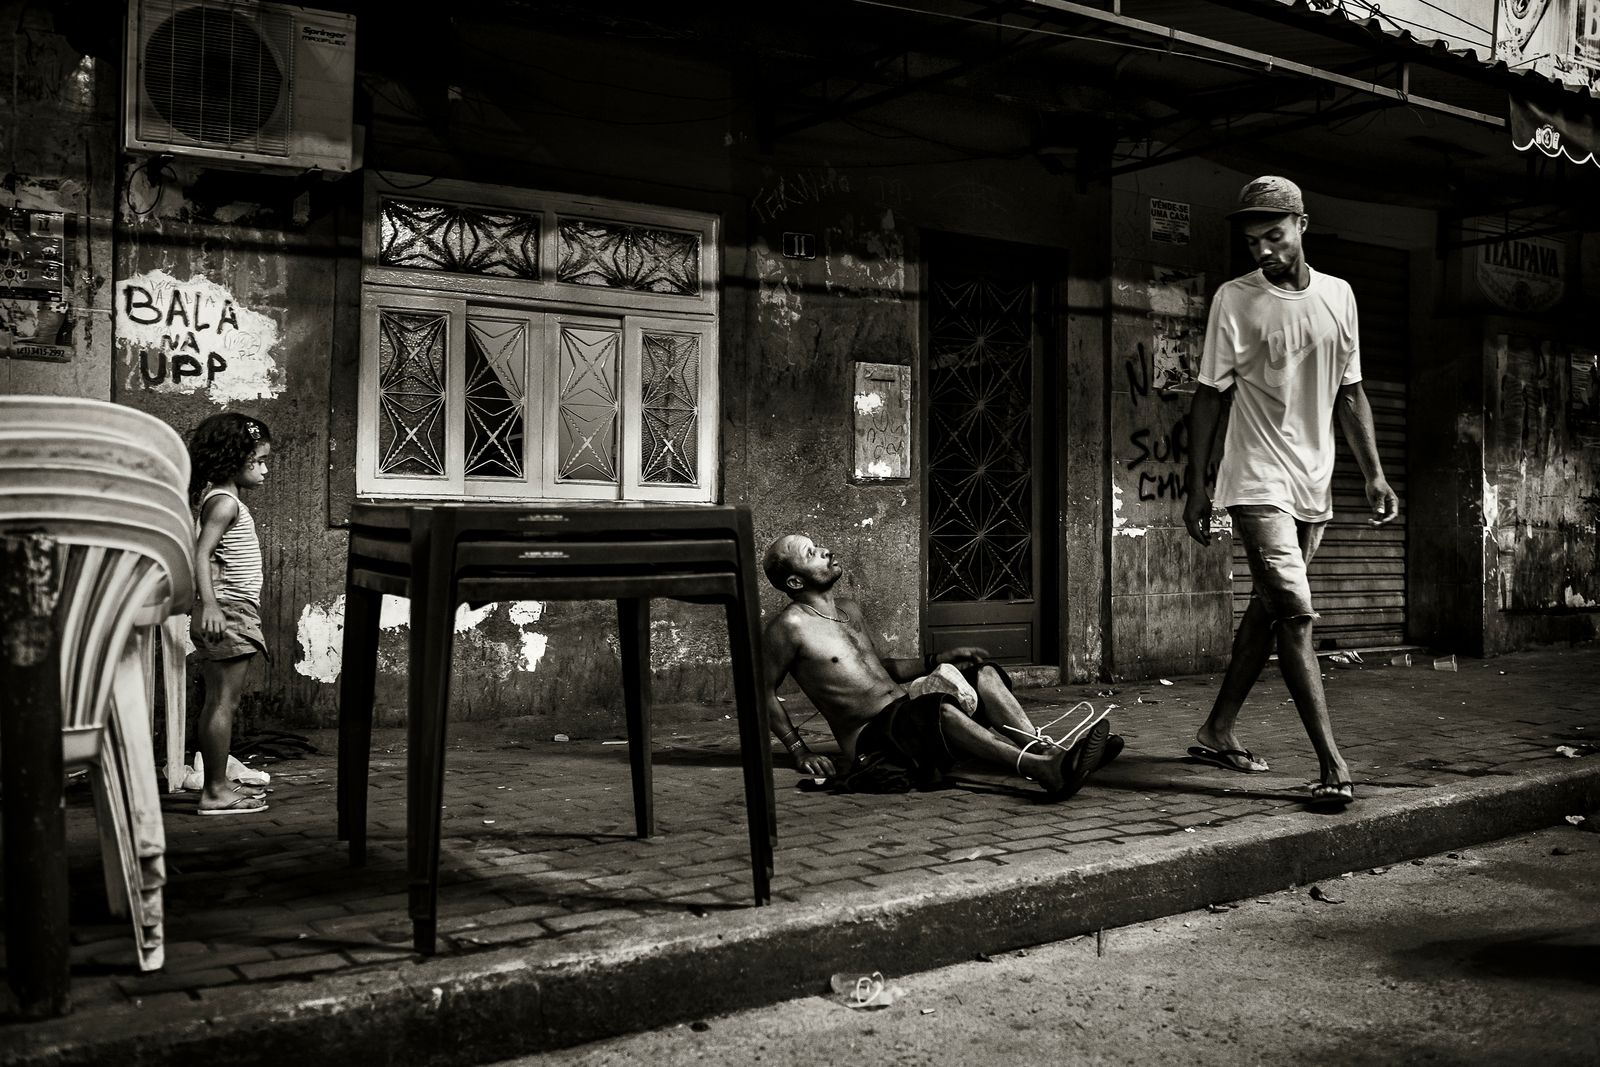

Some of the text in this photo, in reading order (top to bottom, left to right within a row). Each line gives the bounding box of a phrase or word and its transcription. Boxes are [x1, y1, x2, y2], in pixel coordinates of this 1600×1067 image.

[303, 26, 346, 38] Springer
[1151, 209, 1189, 222] UMA CASA
[123, 285, 239, 334] BALA
[161, 332, 200, 354] NA
[140, 351, 228, 389] UPP
